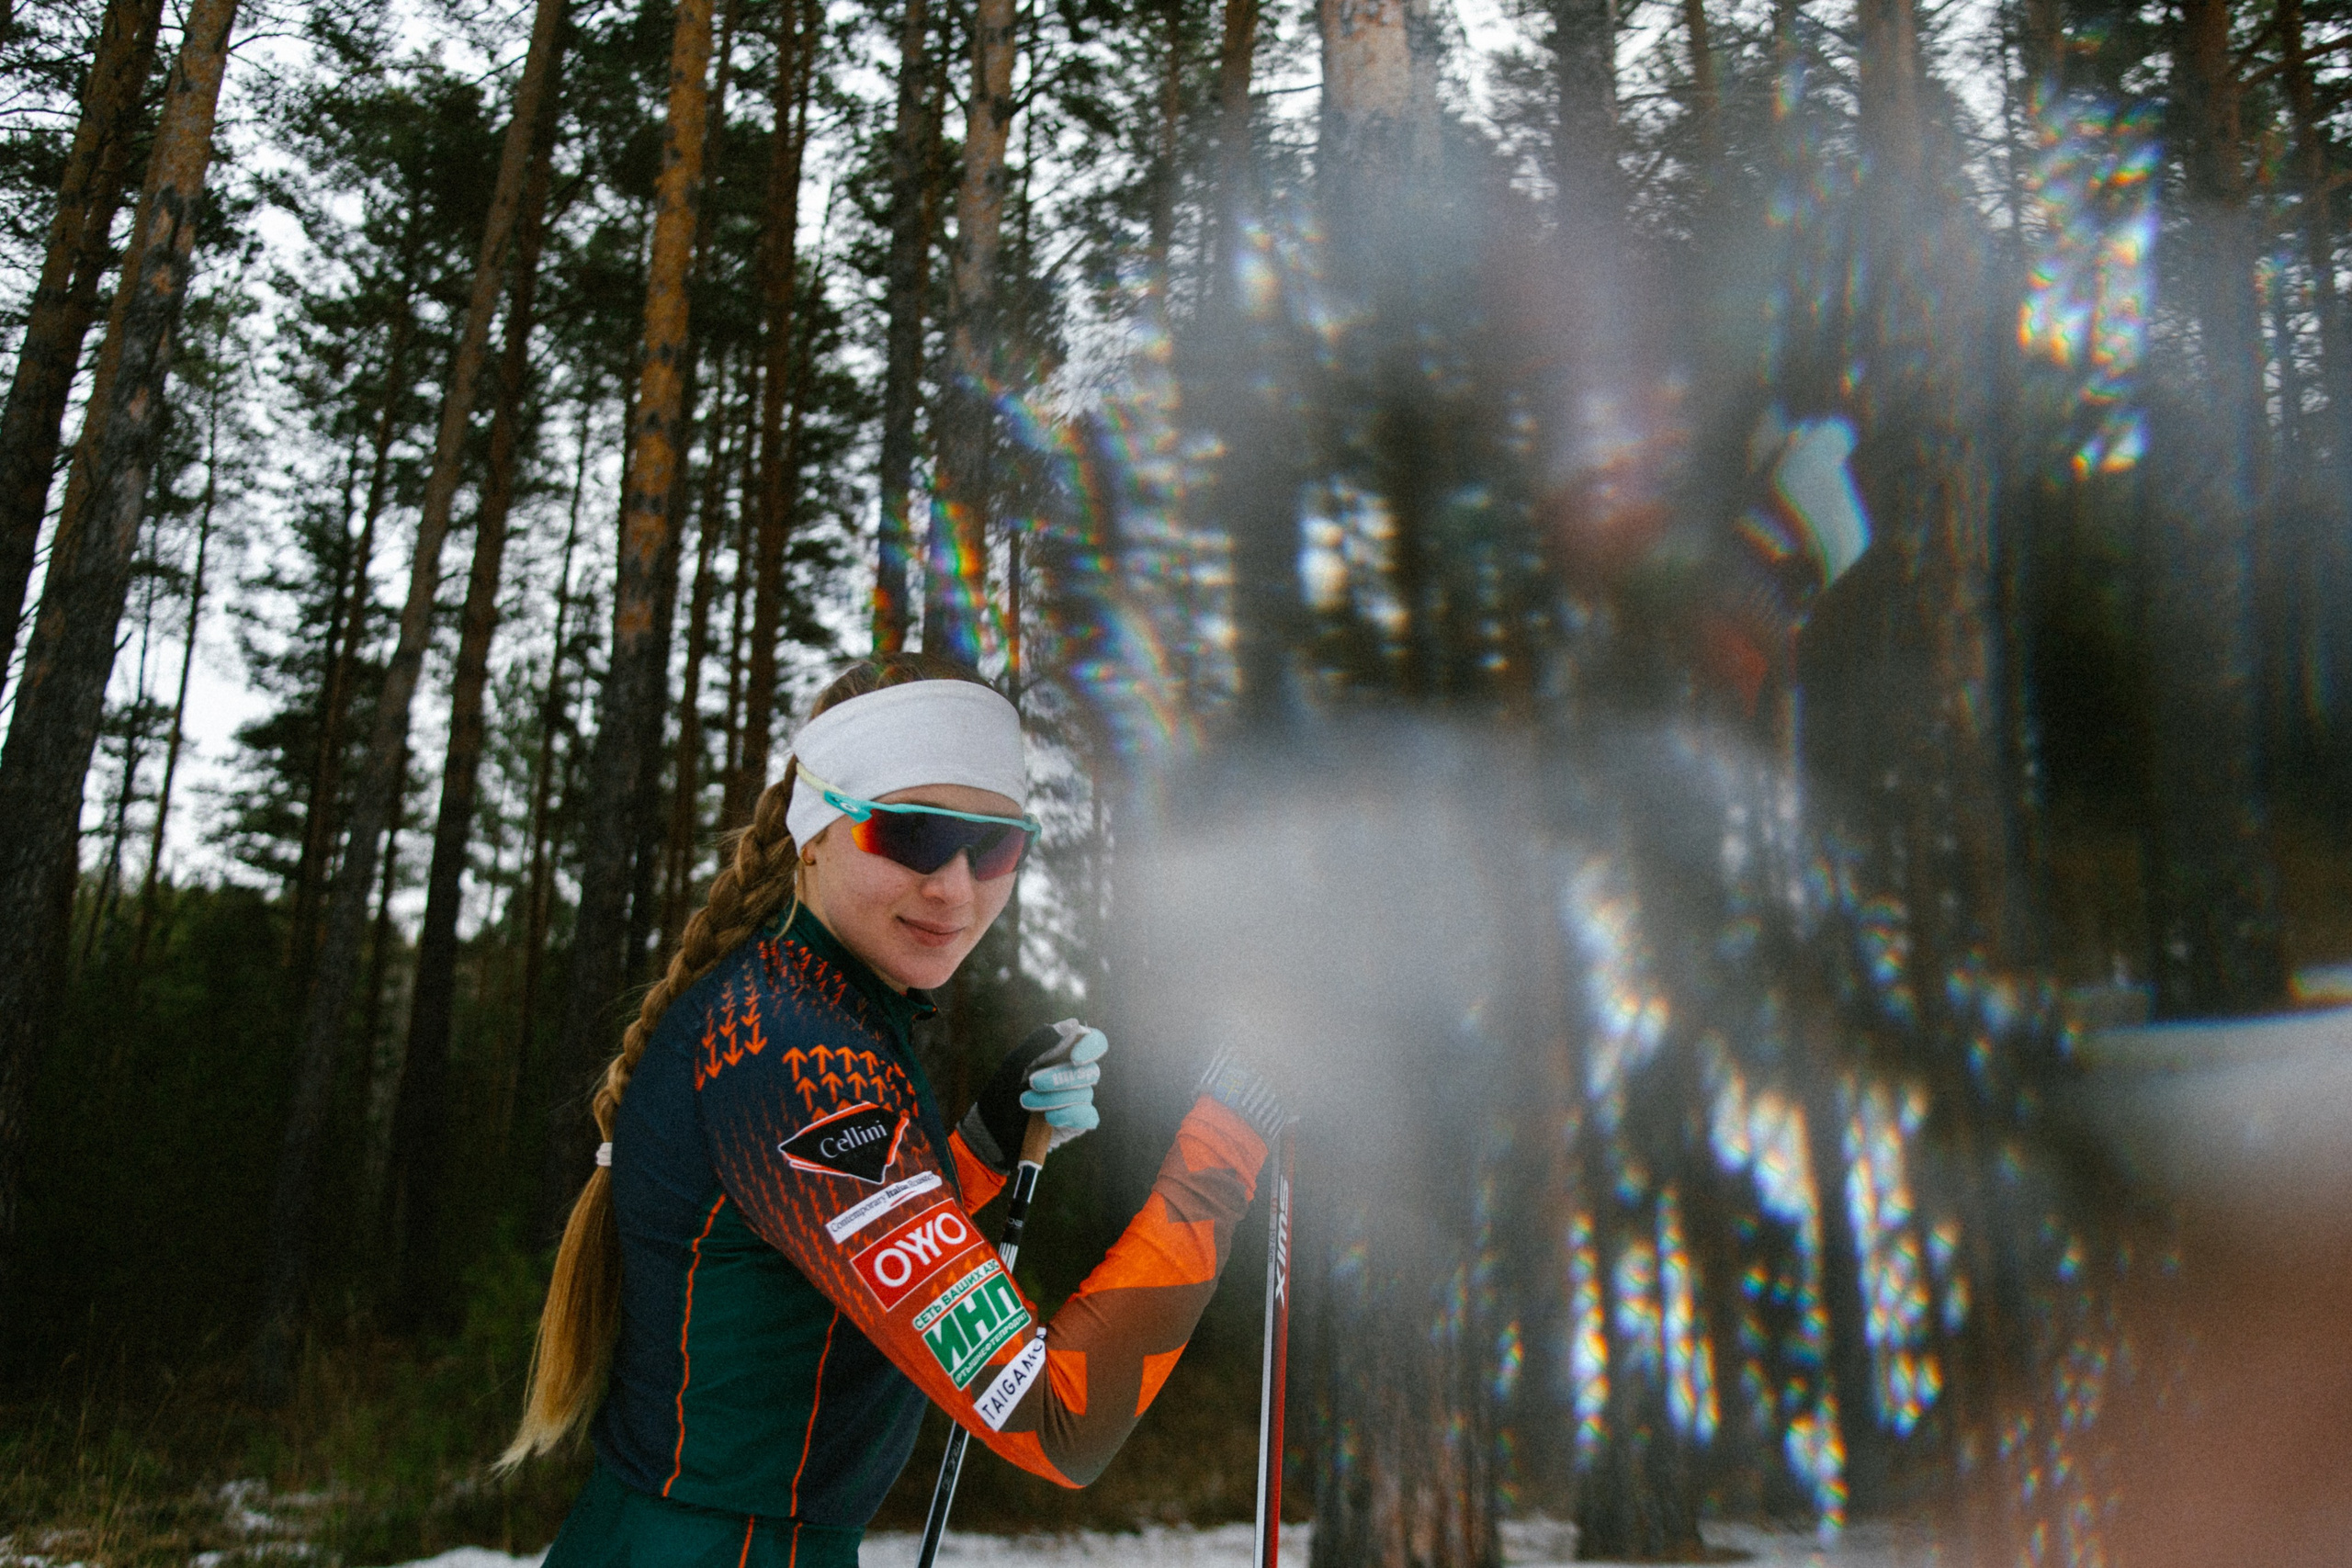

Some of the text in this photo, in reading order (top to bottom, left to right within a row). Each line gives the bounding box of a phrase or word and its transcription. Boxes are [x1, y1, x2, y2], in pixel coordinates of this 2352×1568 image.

[820, 1120, 888, 1158] Cellini
[830, 1194, 888, 1233] Contemporary
[914, 1259, 1000, 1329] СЕТЬ ВАШИХ АЗС
[923, 1271, 1023, 1374] ИНП
